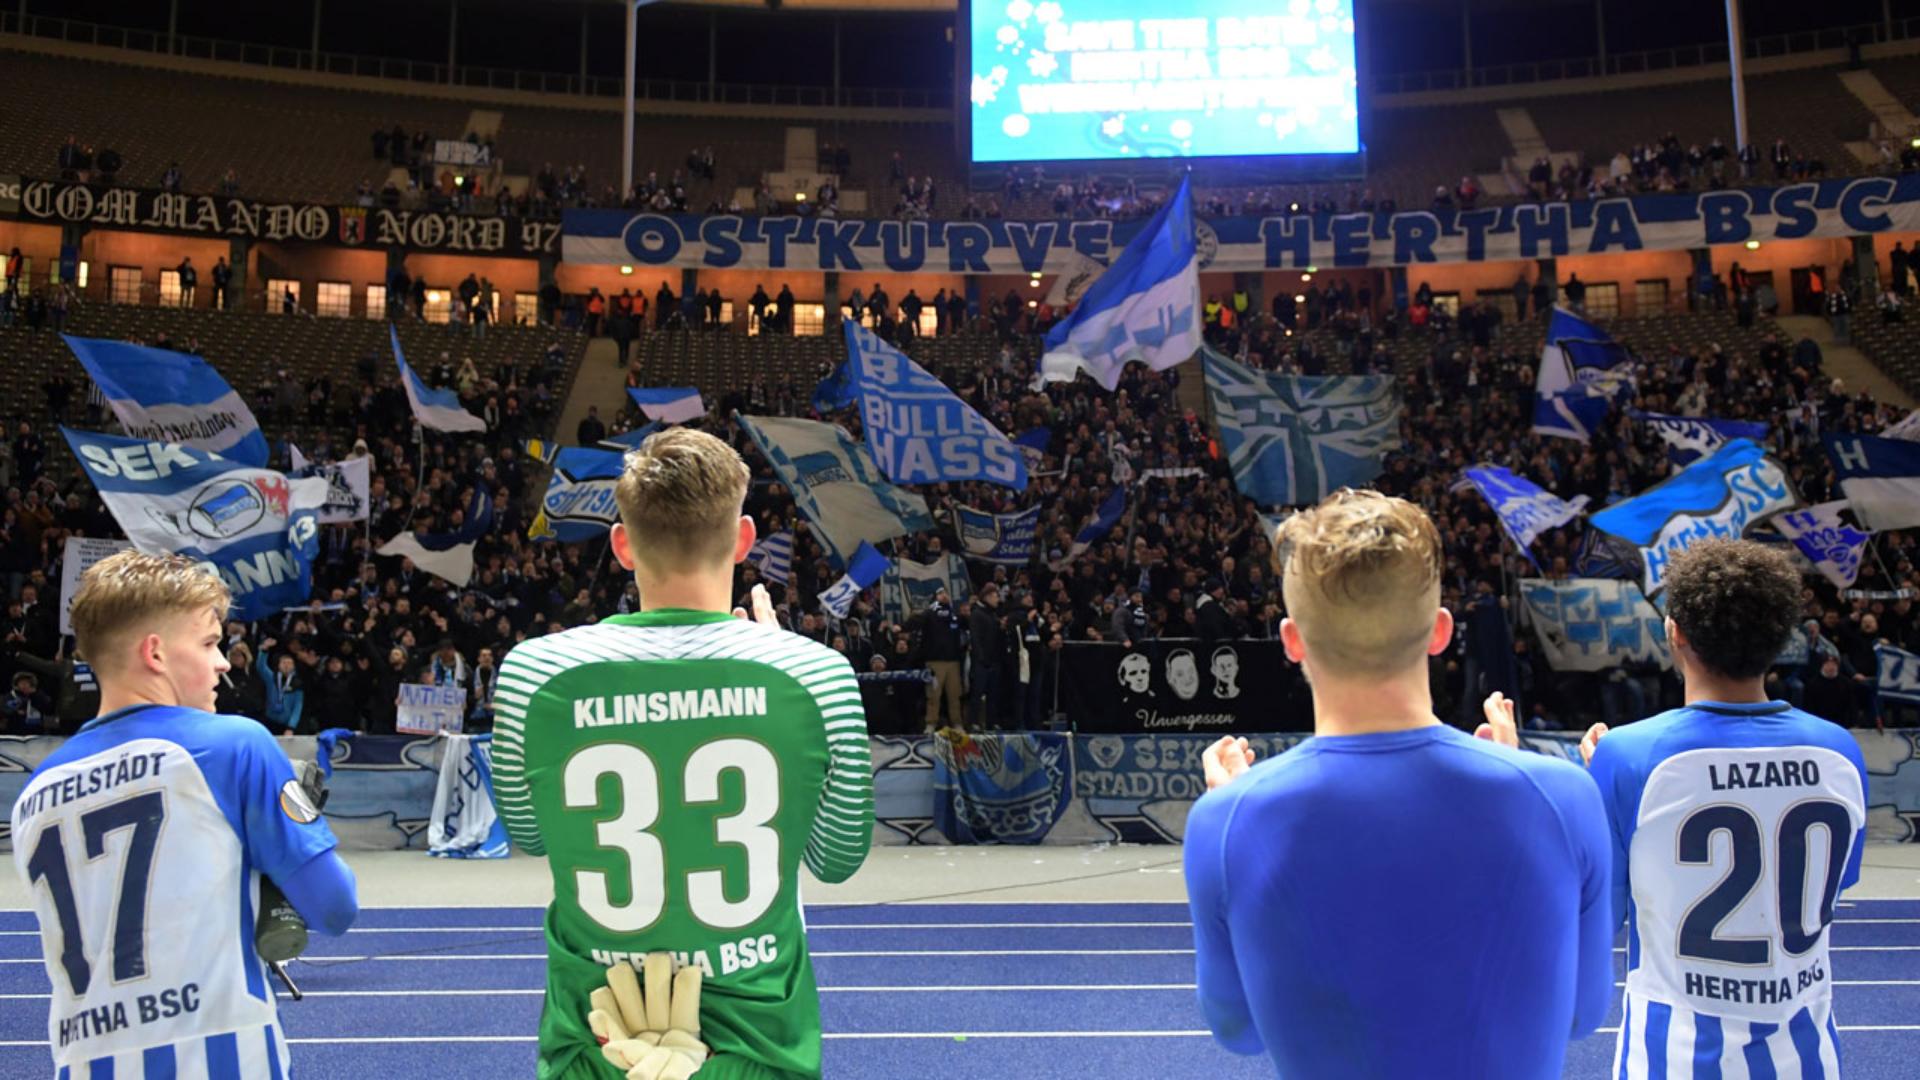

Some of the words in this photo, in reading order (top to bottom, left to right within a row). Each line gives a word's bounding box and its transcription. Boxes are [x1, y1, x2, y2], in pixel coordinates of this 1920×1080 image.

[377, 209, 507, 252] NORD
[622, 213, 1113, 272] OSTKURVE
[1259, 198, 1645, 268] HERTHA
[1698, 176, 1898, 245] BSC
[868, 427, 1017, 482] HASS
[573, 687, 767, 728] KLINSMANN
[19, 751, 167, 824] MITTELSTÄDT
[1708, 759, 1821, 792] LAZARO
[563, 737, 781, 932] 33
[27, 788, 168, 998] 17
[1676, 798, 1853, 967] 20
[591, 948, 715, 977] HERHA
[720, 934, 778, 975] BSC
[137, 982, 200, 1025] BSC
[1685, 971, 1793, 1005] HERTHA
